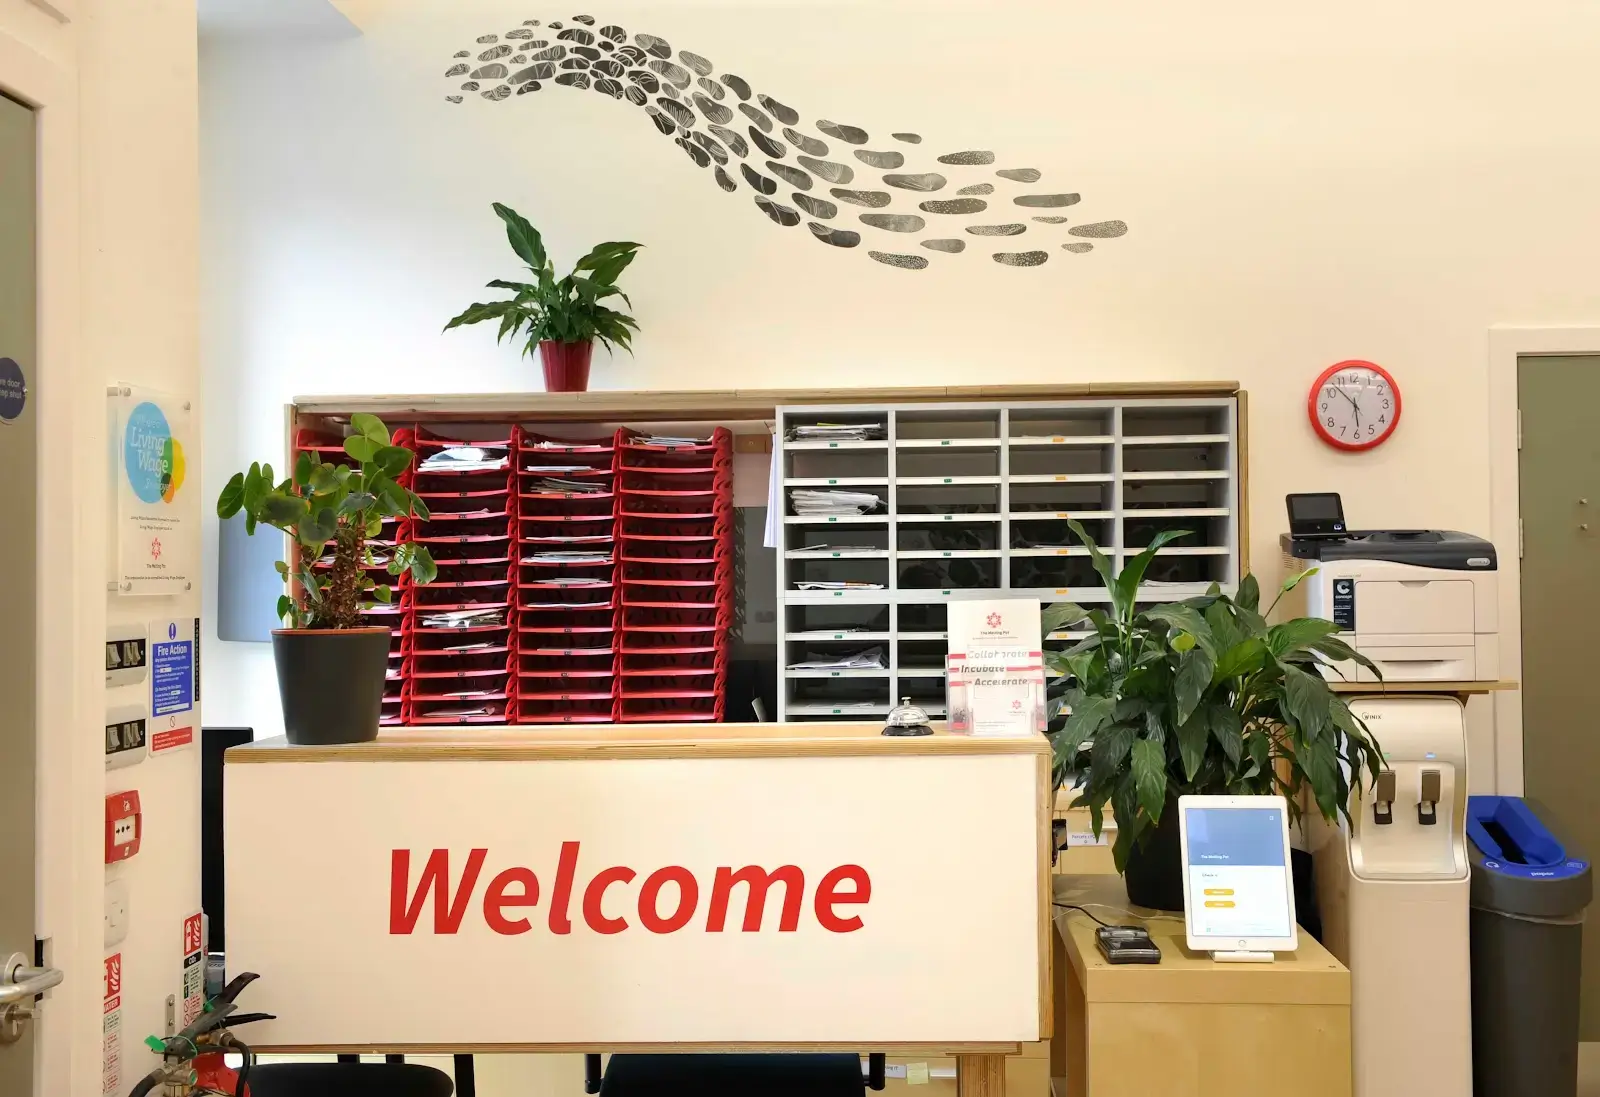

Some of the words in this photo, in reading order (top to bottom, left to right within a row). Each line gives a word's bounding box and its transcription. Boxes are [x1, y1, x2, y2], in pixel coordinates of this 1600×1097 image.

[1337, 377, 1345, 386] 11
[1349, 373, 1359, 384] 12
[1367, 376, 1371, 385] 1
[1326, 388, 1337, 398] 10
[1377, 385, 1384, 395] 2
[1321, 403, 1328, 413] 9
[1382, 399, 1389, 409] 3
[1327, 417, 1335, 427] 8
[1378, 414, 1385, 424] 4
[1340, 426, 1347, 436] 7
[1353, 428, 1360, 439] 6
[1368, 425, 1375, 435] 5
[131, 428, 166, 457] Living
[138, 450, 169, 478] Wage
[157, 645, 169, 657] Fire
[169, 644, 187, 655] Action
[960, 665, 1005, 673] Incubate
[974, 678, 1028, 686] Accelerate
[389, 841, 872, 935] Welcome
